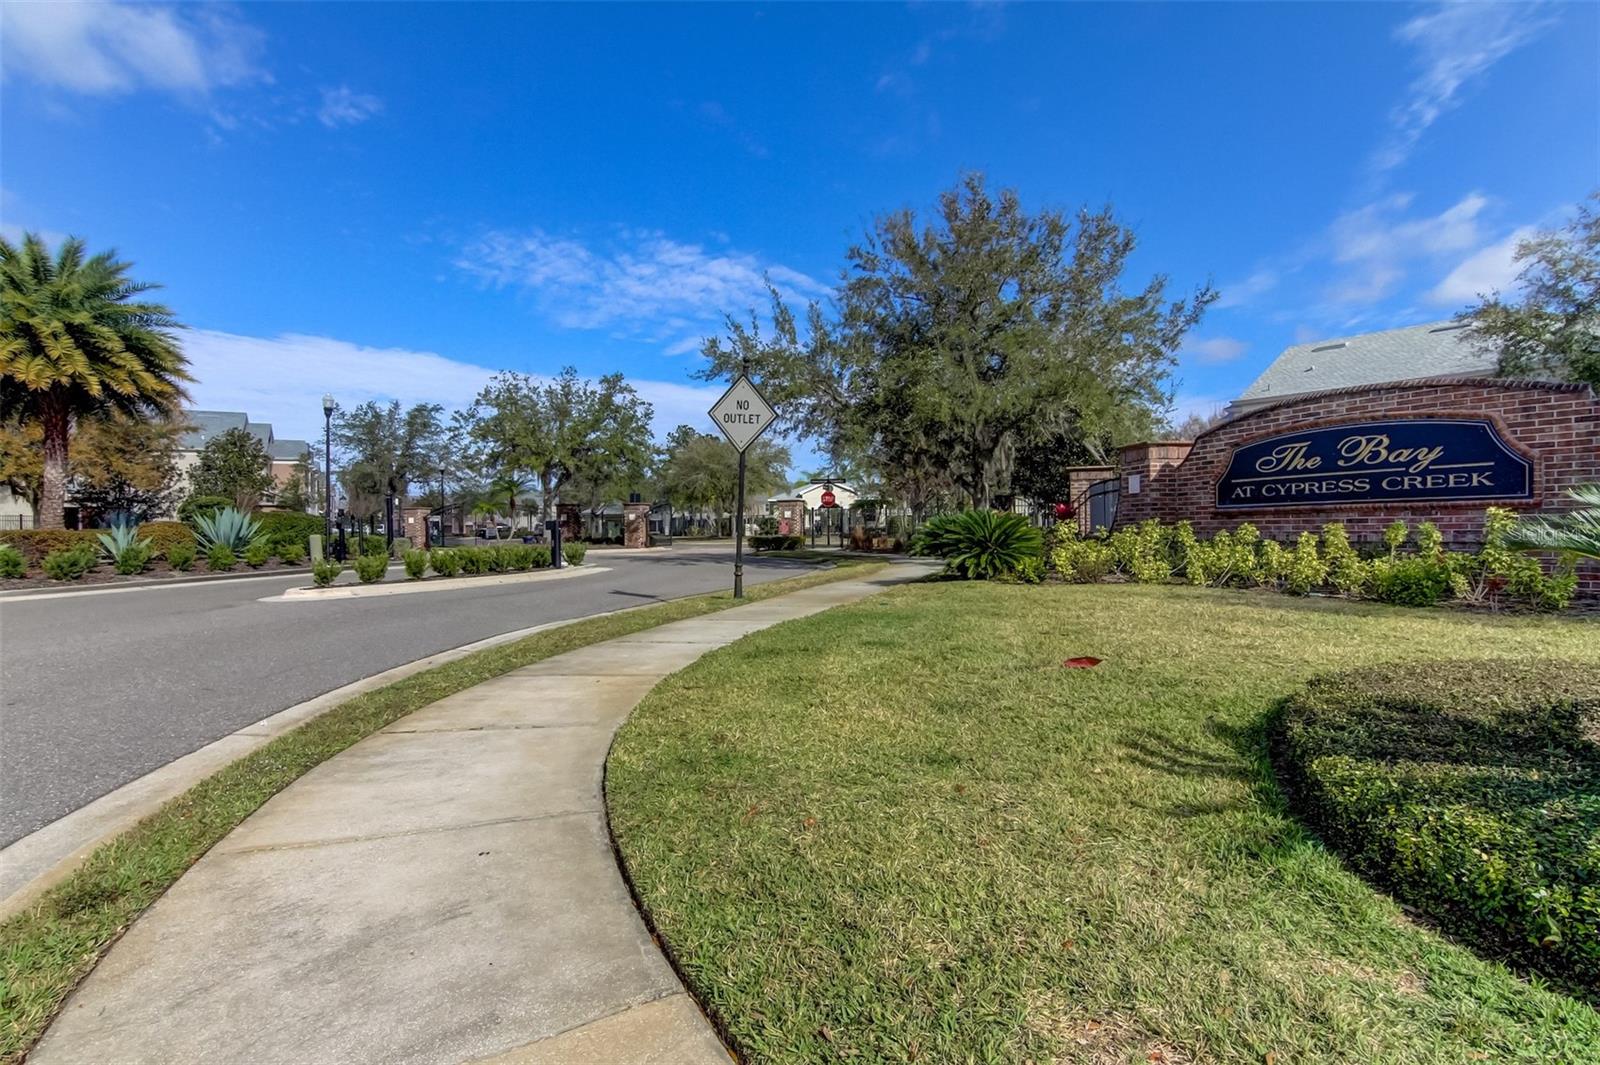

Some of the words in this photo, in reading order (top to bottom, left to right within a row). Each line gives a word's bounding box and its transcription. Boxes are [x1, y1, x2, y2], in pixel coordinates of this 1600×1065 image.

[736, 399, 750, 410] NO
[723, 413, 761, 424] OUTLET
[1255, 441, 1322, 473] The
[1336, 434, 1444, 473] Bay
[1231, 486, 1255, 499] AT
[1262, 478, 1370, 497] CYPRESS
[1381, 471, 1494, 490] CREEK
